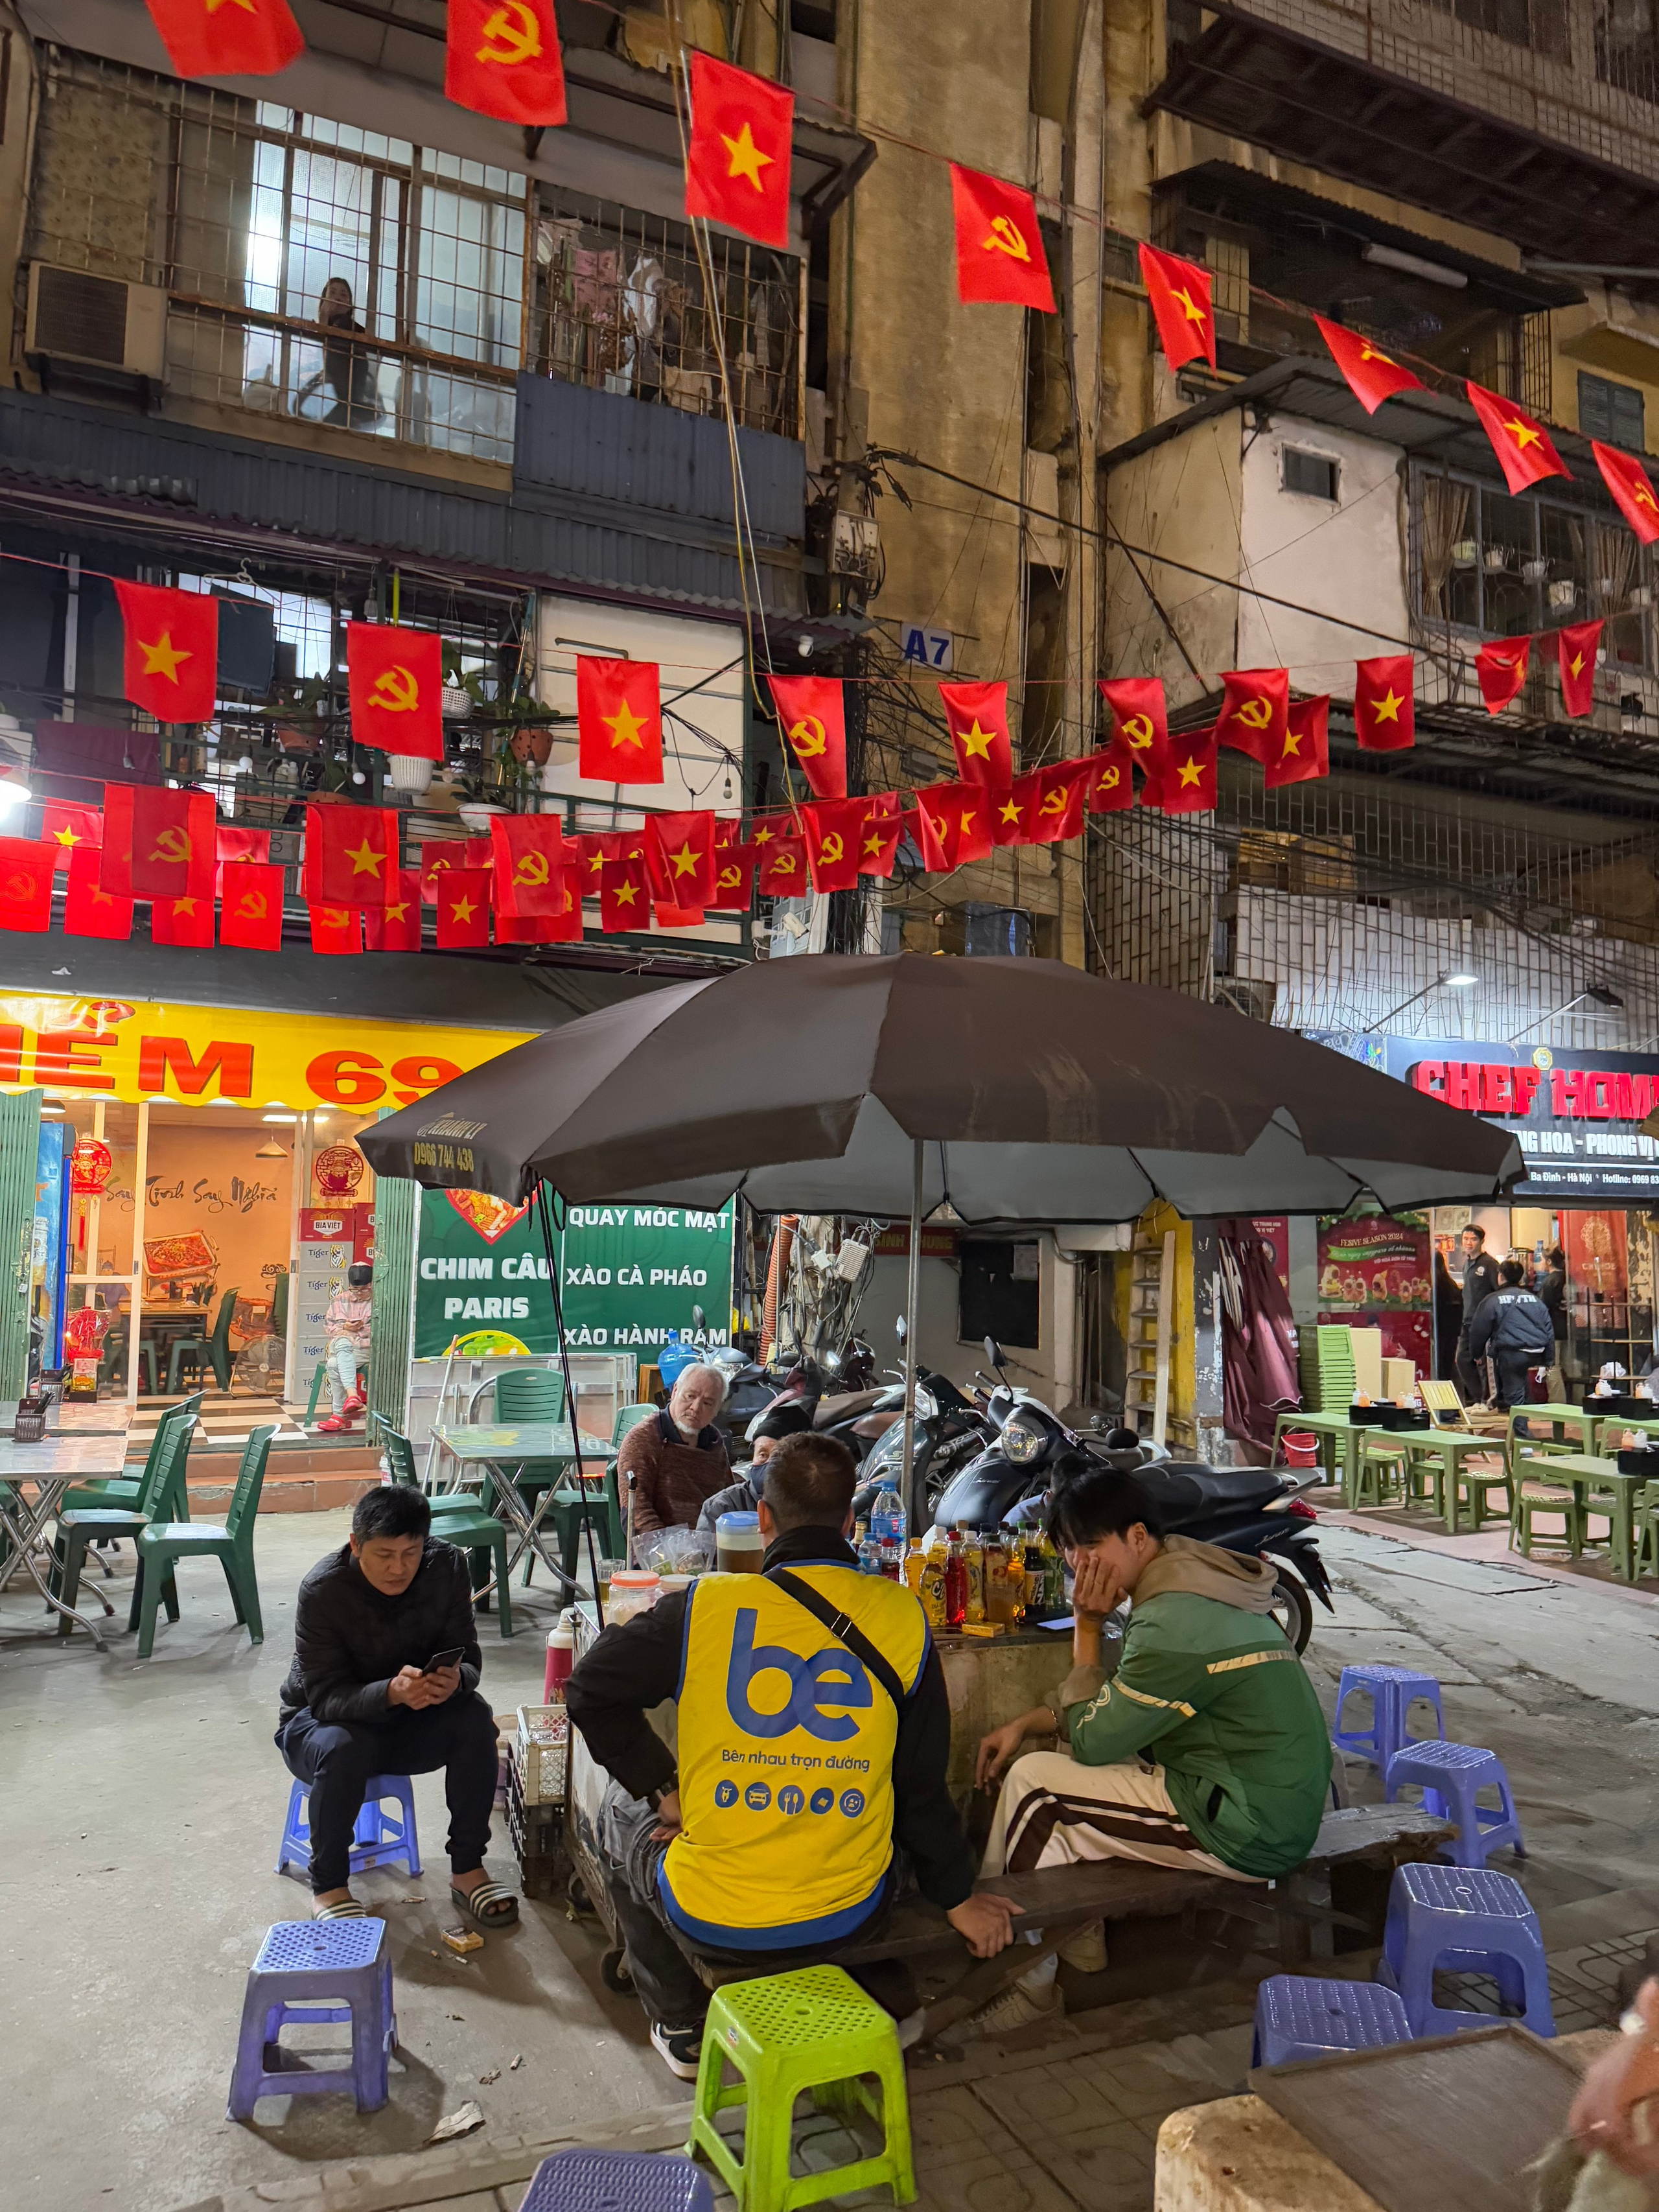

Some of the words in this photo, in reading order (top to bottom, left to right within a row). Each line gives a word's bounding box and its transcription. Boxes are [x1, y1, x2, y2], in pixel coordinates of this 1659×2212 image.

[905, 629, 949, 665] A7
[1411, 1060, 1541, 1115] CHEF
[1549, 1069, 1659, 1119] HOM
[414, 1142, 436, 1166] 0966
[1540, 1131, 1575, 1154] HOA
[1585, 1134, 1638, 1156] PHONG
[1530, 1172, 1542, 1182] Ba
[1567, 1172, 1578, 1183] Hà
[193, 1178, 233, 1213] Say
[569, 1208, 629, 1228] QUAY
[634, 1207, 679, 1228] MÓC
[308, 1248, 329, 1259] Tiger
[421, 1258, 493, 1280] CHIM
[566, 1264, 611, 1285] XÀO
[618, 1264, 644, 1285] CÀ
[650, 1265, 707, 1286] PHÁO
[307, 1279, 328, 1290] Tiger
[306, 1313, 326, 1323] Tiger
[445, 1297, 529, 1320] PARIS
[564, 1324, 607, 1345] XÀO
[303, 1345, 324, 1355] Tiger
[726, 1608, 873, 1742] be
[722, 1749, 745, 1763] Bên
[748, 1751, 787, 1765] nhau
[791, 1753, 821, 1771] trọn
[825, 1755, 870, 1773] đường
